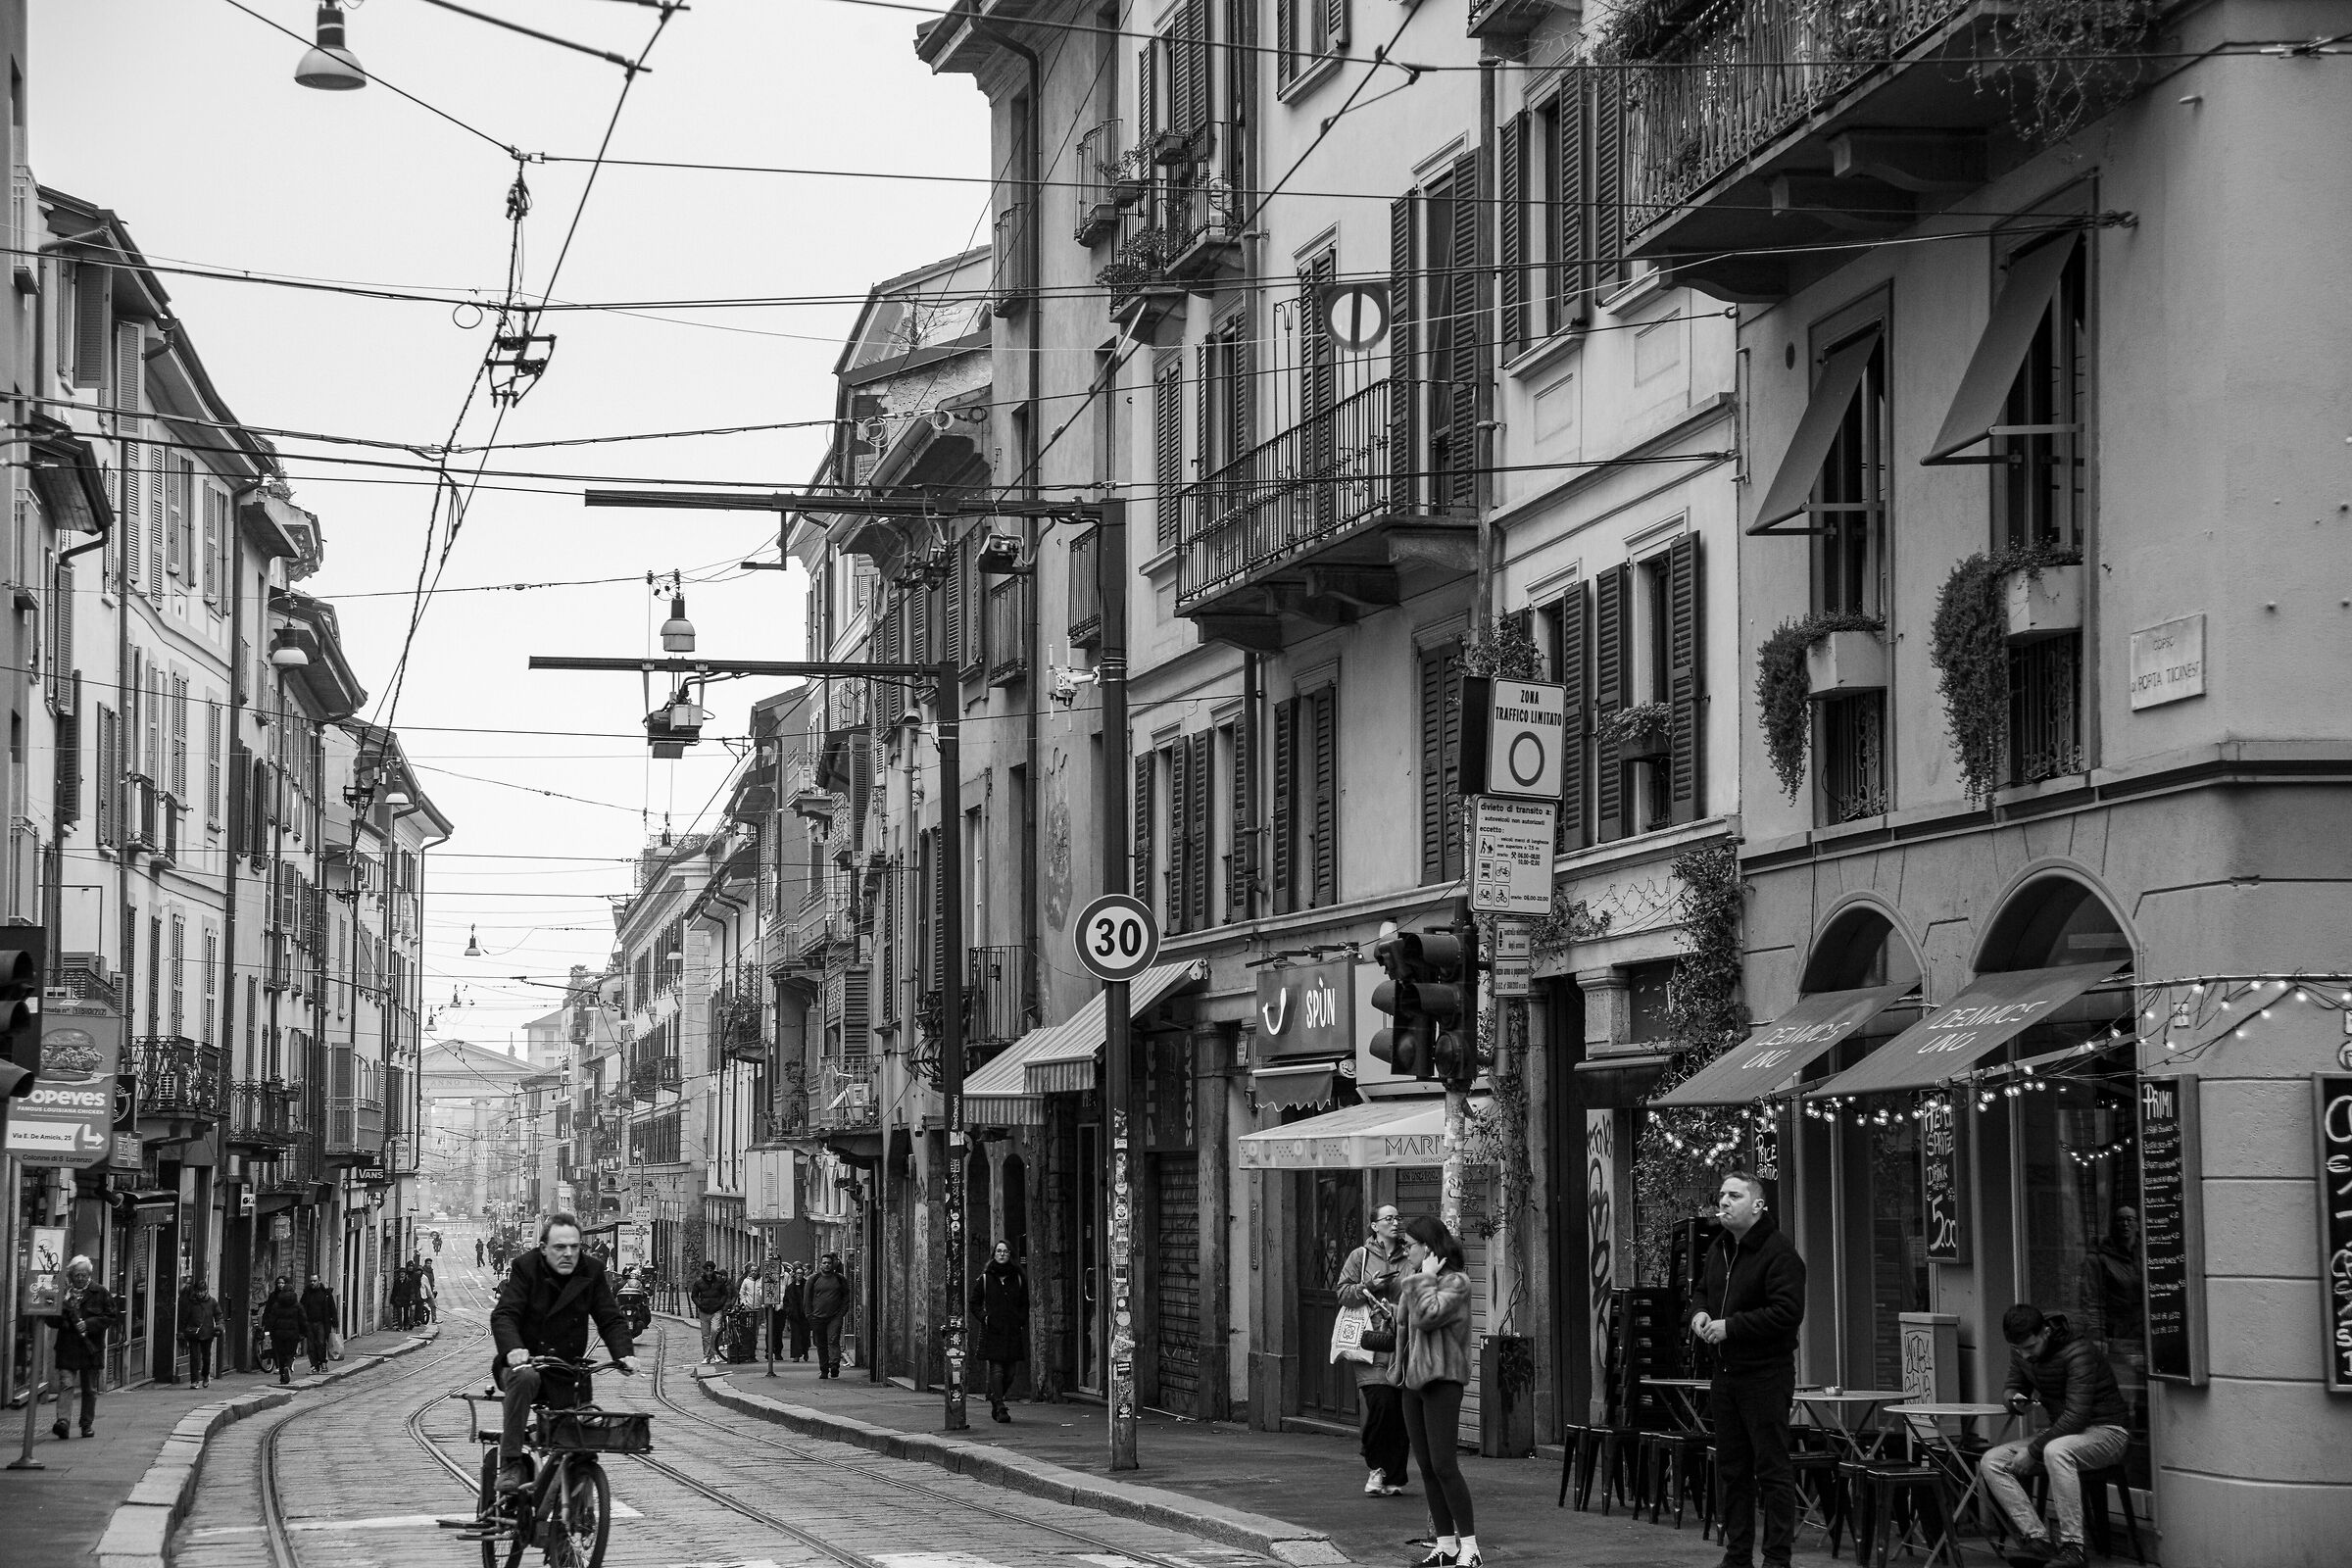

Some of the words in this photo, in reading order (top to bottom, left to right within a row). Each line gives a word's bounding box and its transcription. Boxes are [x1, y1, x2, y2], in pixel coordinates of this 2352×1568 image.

[2138, 672, 2162, 690] PORTA
[1520, 690, 1540, 705] ZONA
[1495, 707, 1529, 723] TRAFFICO
[1530, 710, 1562, 726] LIMITATO
[1480, 803, 1504, 813] divieto
[1516, 806, 1544, 815] transito
[1479, 825, 1505, 834] eccetto:
[1095, 917, 1142, 956] 30
[1306, 977, 1336, 1029] SPÙN
[1917, 1031, 1978, 1054] UNO
[2142, 1083, 2173, 1120] PRIMI
[23, 1153, 52, 1162] Colonne
[359, 1168, 384, 1180] VANS
